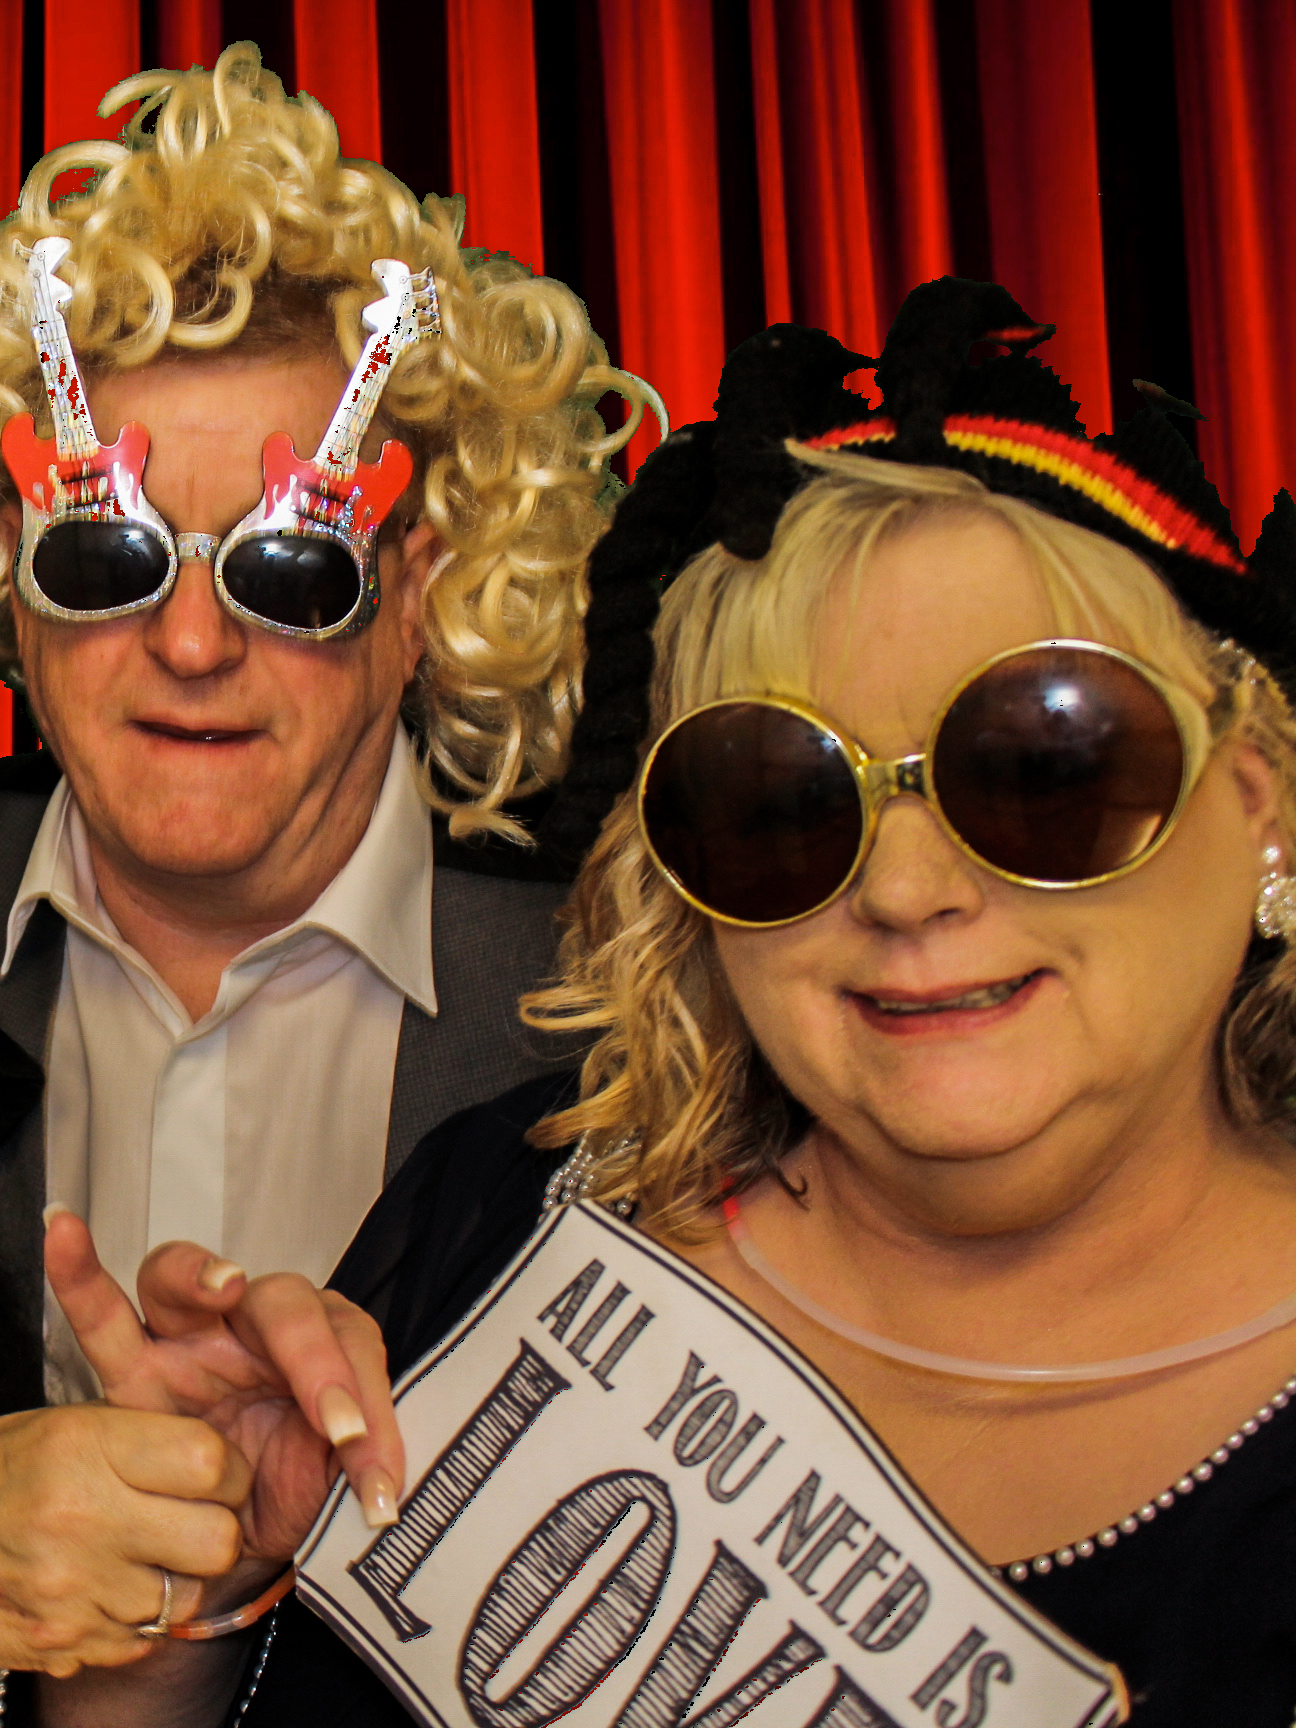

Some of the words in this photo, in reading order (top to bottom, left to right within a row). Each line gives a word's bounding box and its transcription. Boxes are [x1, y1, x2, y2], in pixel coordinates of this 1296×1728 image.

[346, 1337, 904, 1728] LOV
[536, 1258, 656, 1392] ALL
[643, 1350, 786, 1504] YOU
[753, 1468, 932, 1654] NEED
[909, 1624, 1015, 1728] IS
